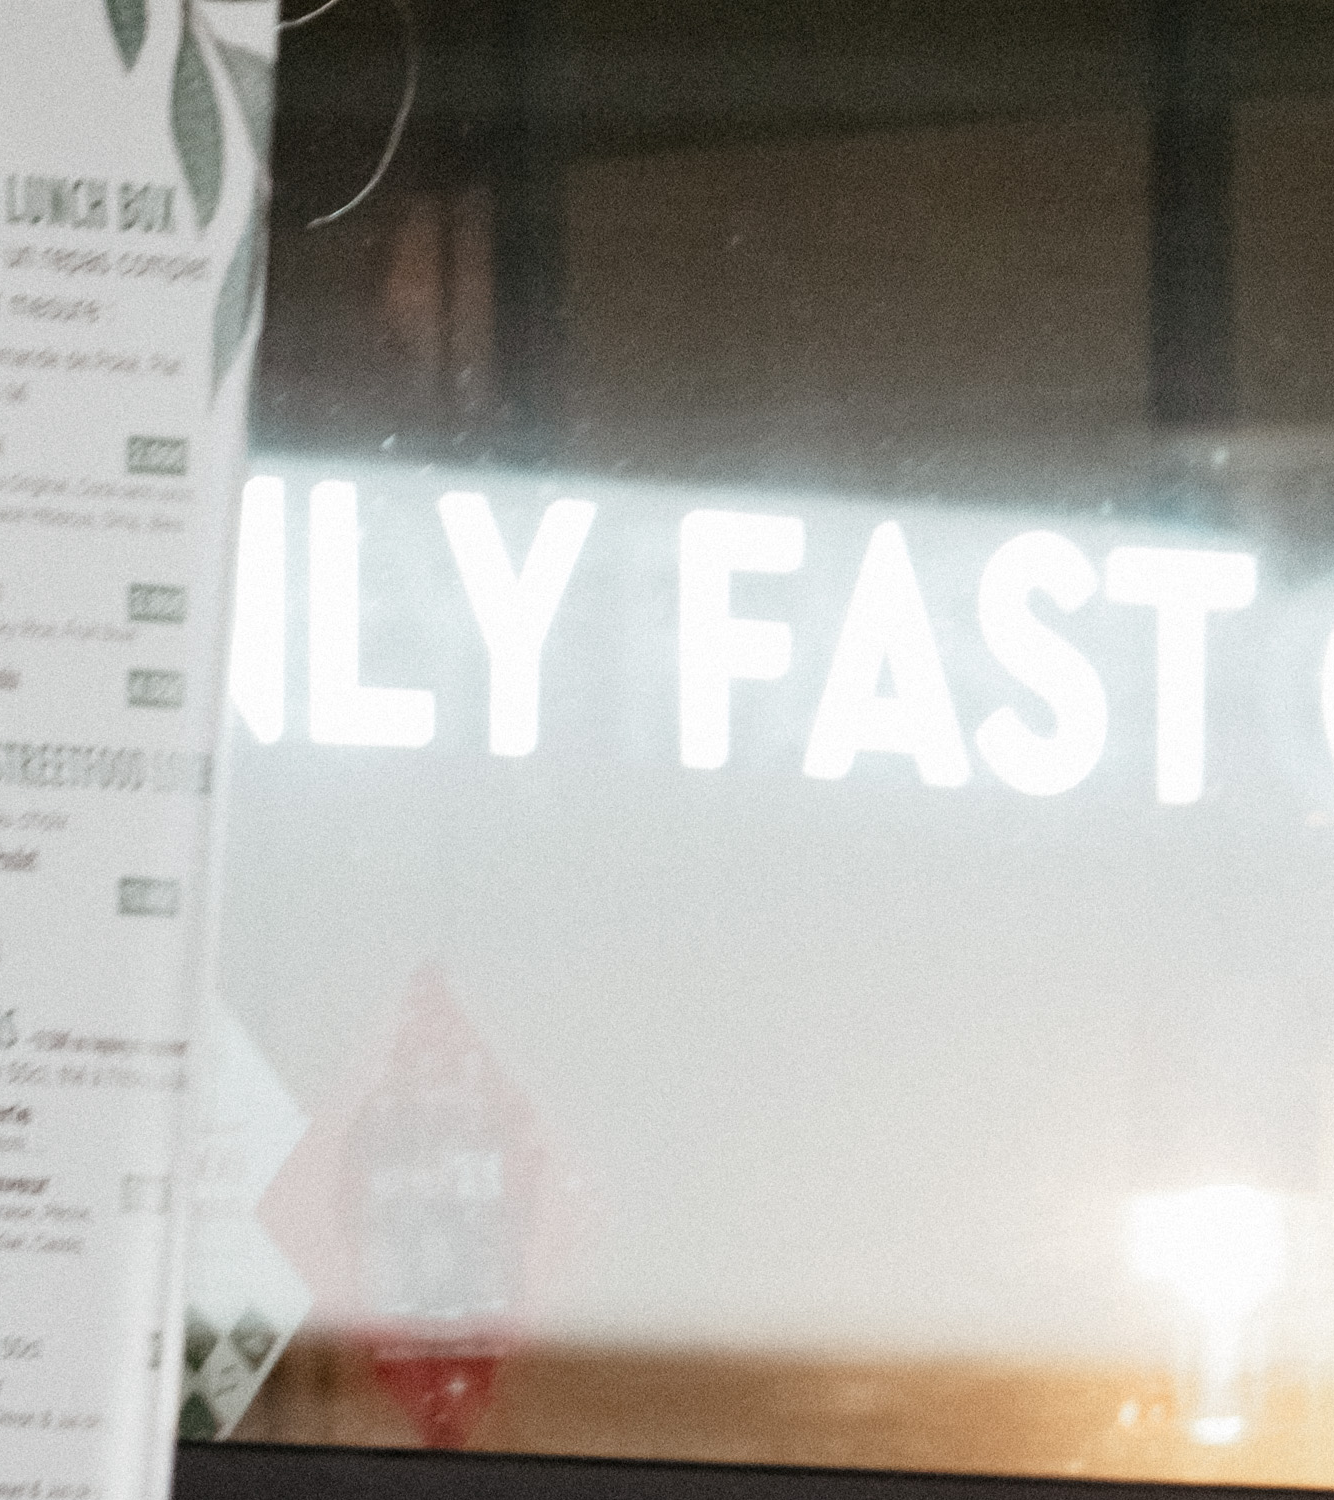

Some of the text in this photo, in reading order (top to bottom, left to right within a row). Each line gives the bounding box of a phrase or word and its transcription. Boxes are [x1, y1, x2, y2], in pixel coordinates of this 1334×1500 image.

[6, 173, 108, 229] LUNCH
[119, 182, 175, 234] BOX
[678, 505, 1259, 805] FAST
